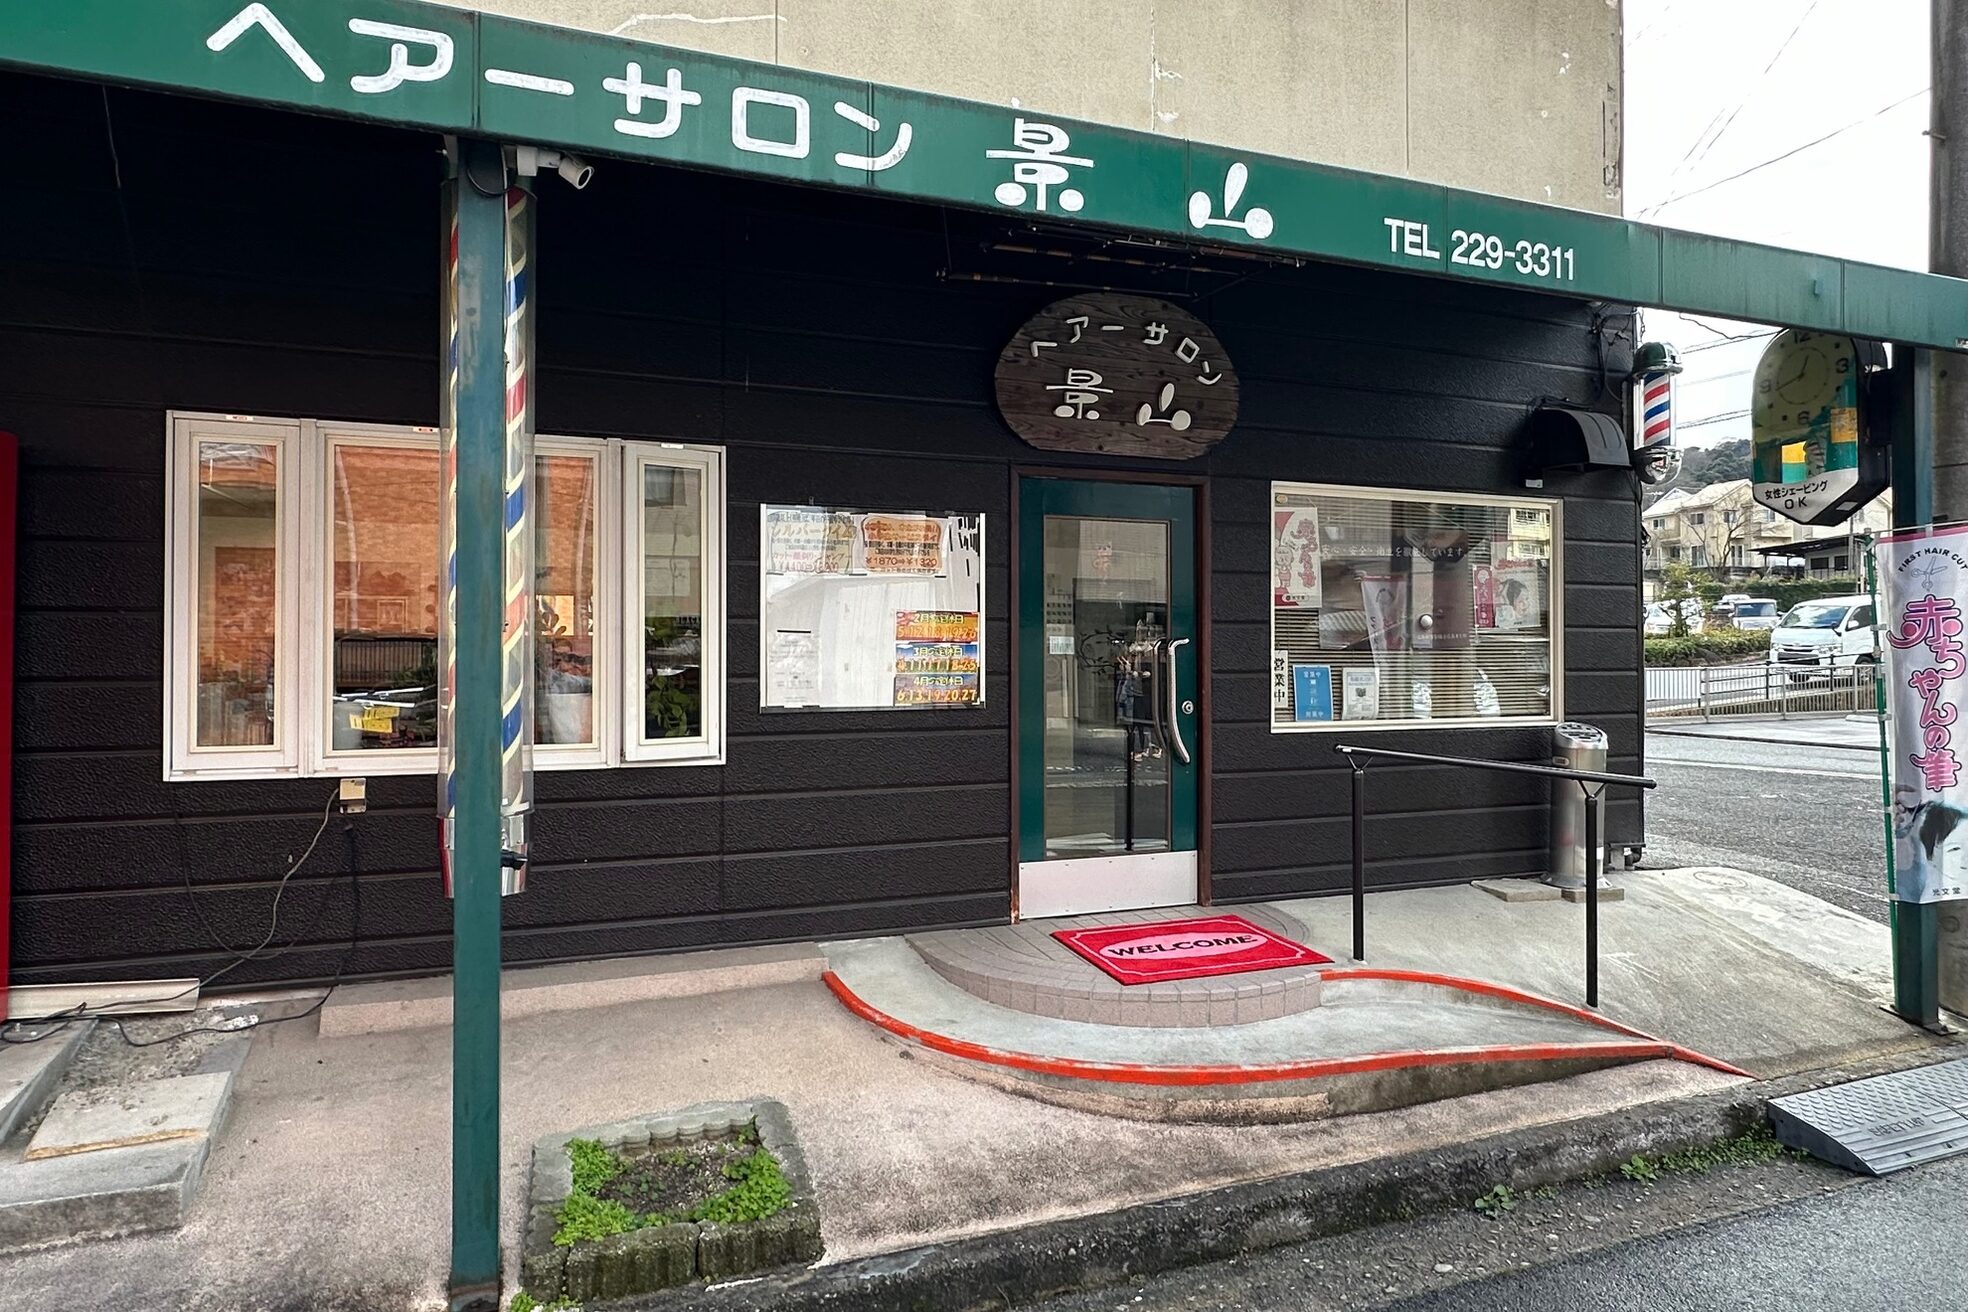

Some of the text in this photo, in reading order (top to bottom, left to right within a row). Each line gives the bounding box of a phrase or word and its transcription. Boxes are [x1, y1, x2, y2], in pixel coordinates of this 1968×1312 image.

[206, 2, 1575, 281] ヘアーサロン 景山 TEL 229-3311
[1030, 316, 1222, 386] ヘアーサロン
[1046, 368, 1191, 431] 景山
[1765, 480, 1828, 500] 女性シェービング
[1784, 496, 1807, 510] OK
[1898, 548, 1968, 573] FIRST HAIR CUT
[1274, 657, 1286, 703] 営業中
[1886, 594, 1966, 792] 赤ちゃんの筆
[1108, 935, 1257, 956] WELCOME
